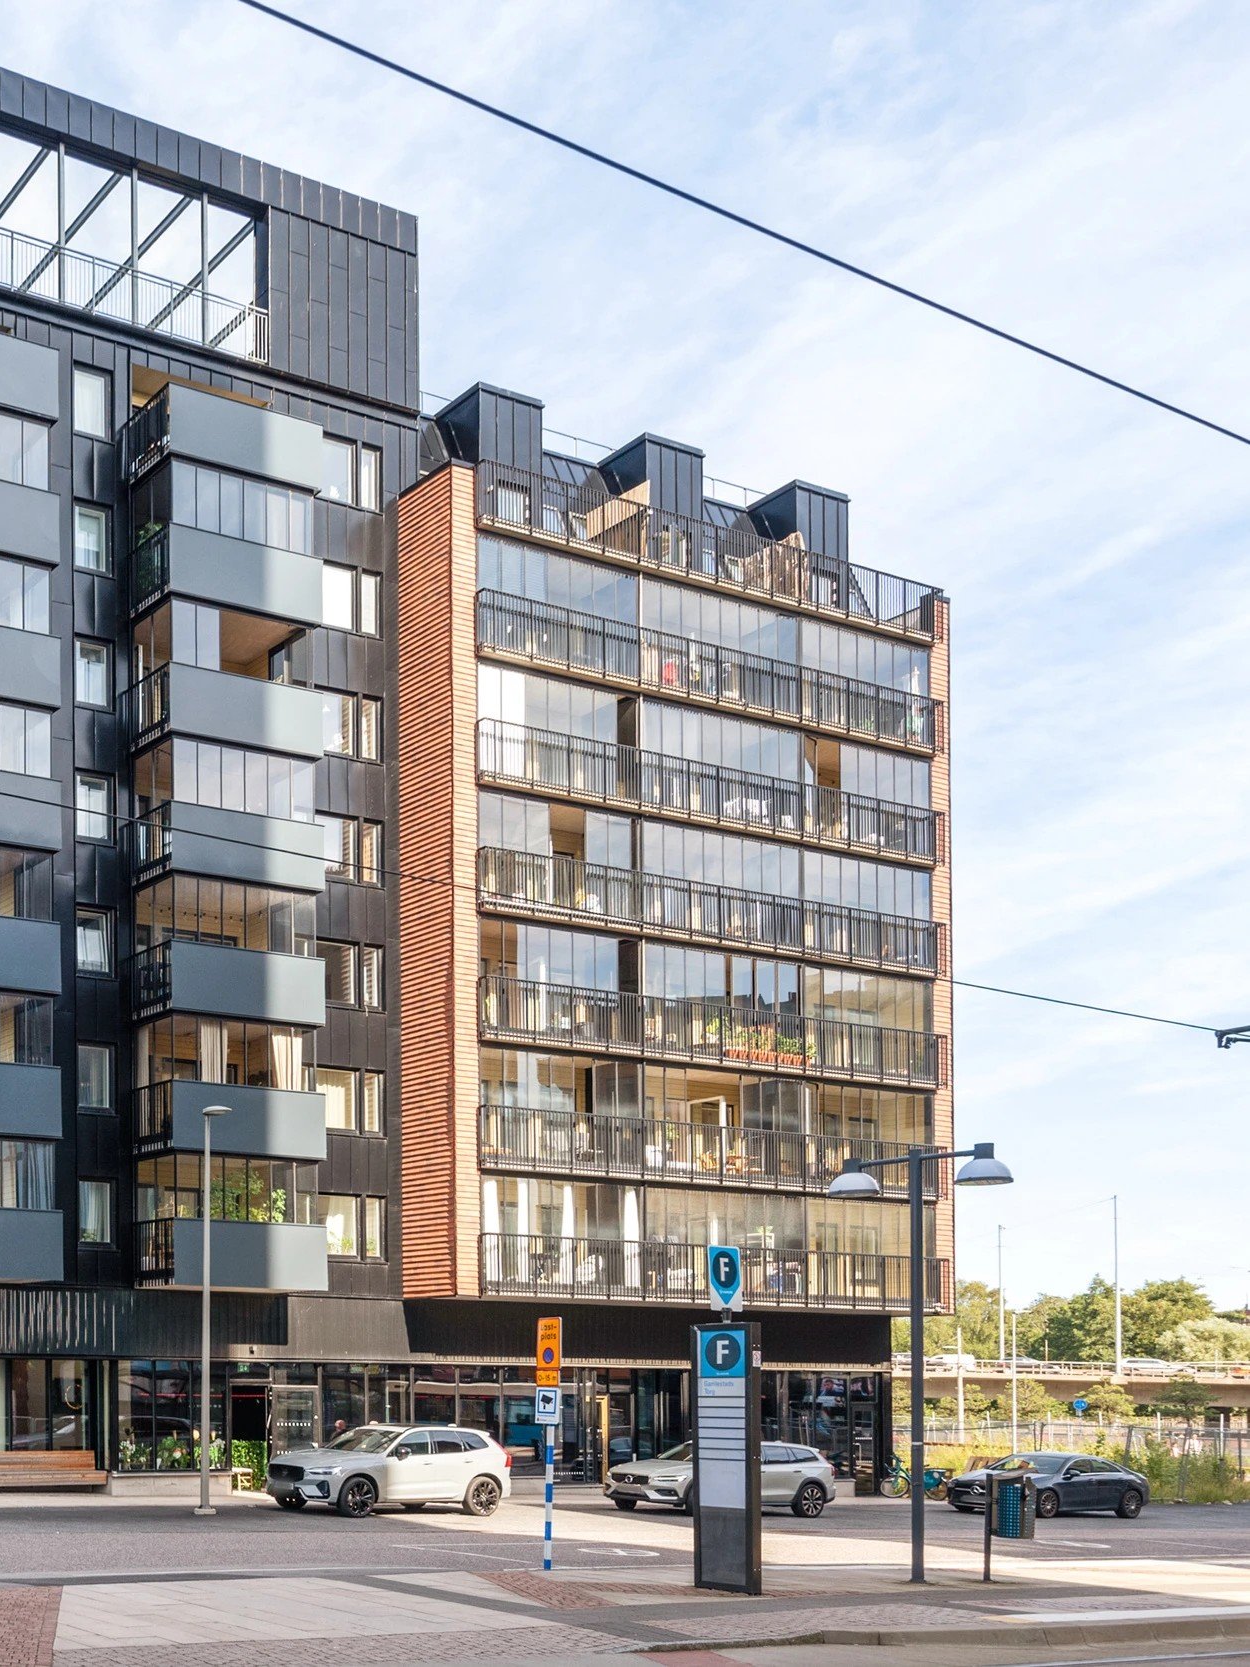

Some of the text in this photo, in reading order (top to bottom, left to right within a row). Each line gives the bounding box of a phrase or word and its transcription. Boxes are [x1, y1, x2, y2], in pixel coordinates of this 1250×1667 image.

[719, 1257, 730, 1282] F
[540, 1332, 557, 1342] plats
[716, 1340, 730, 1365] F
